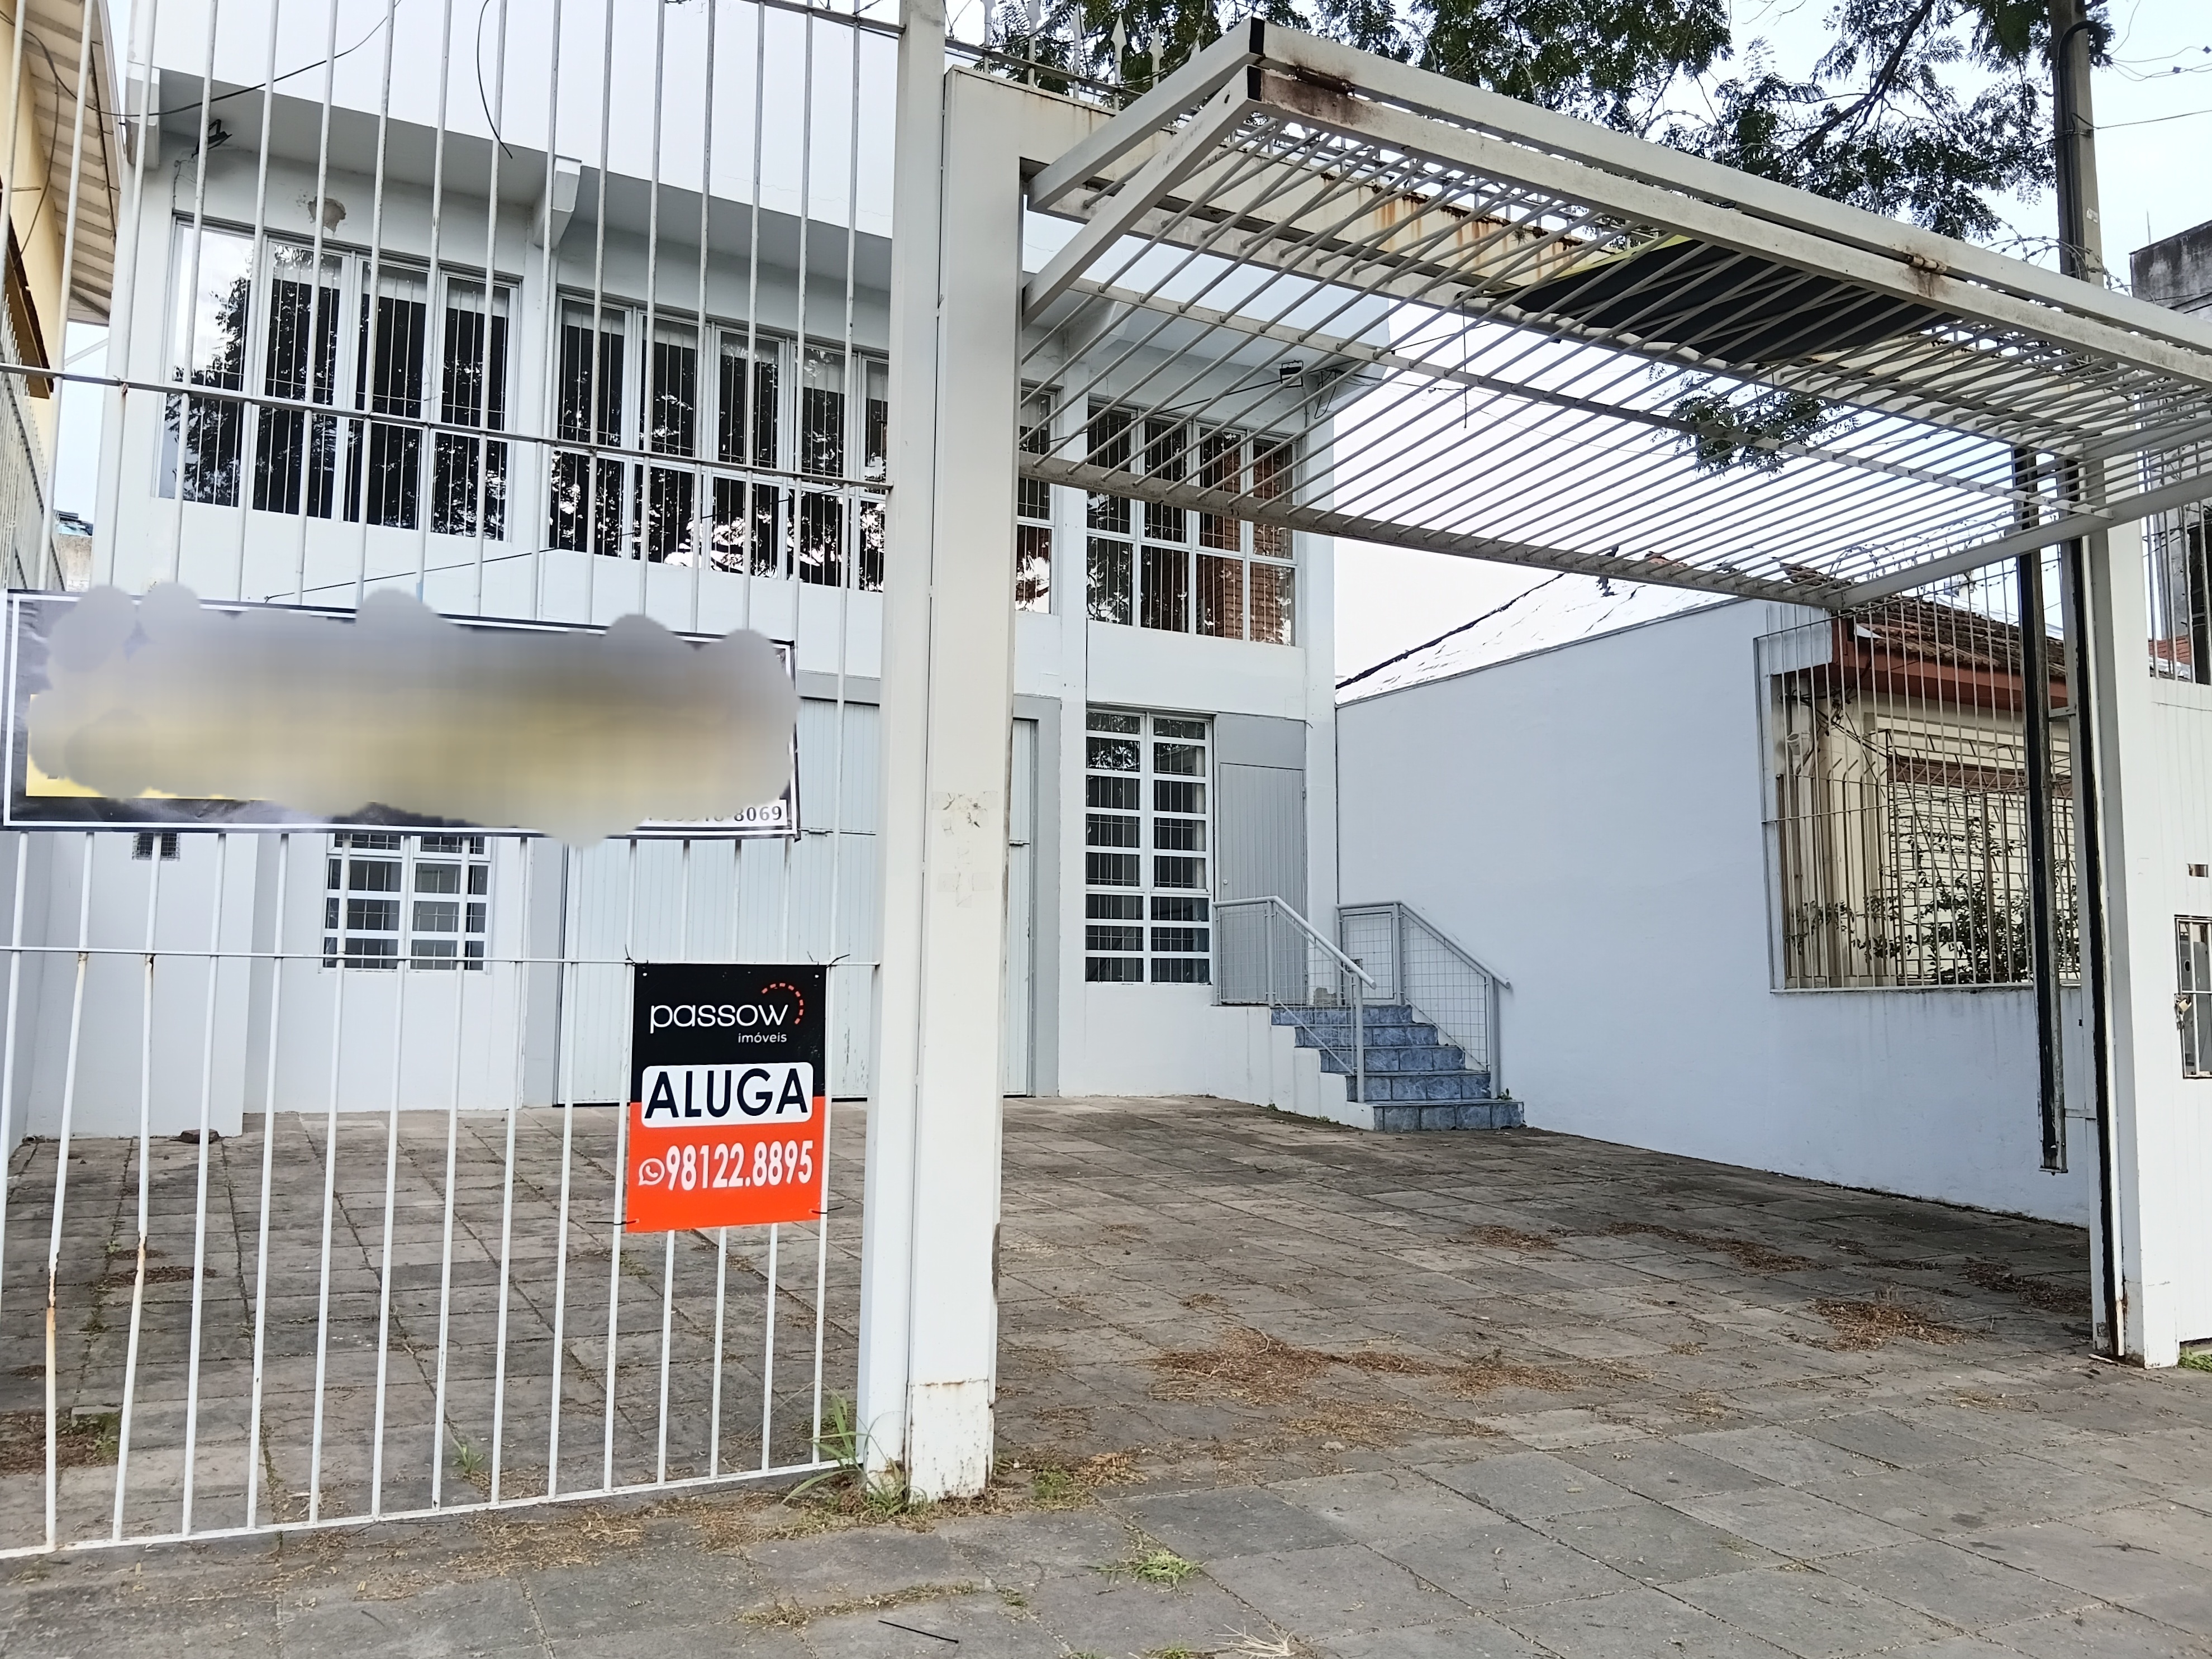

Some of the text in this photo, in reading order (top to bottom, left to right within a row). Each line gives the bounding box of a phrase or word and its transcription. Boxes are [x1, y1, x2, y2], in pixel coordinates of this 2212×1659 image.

[650, 1004, 788, 1034] passow
[738, 1033, 787, 1043] imóveis
[644, 1068, 808, 1119] ALUGA
[666, 1140, 814, 1191] 98122.8895
